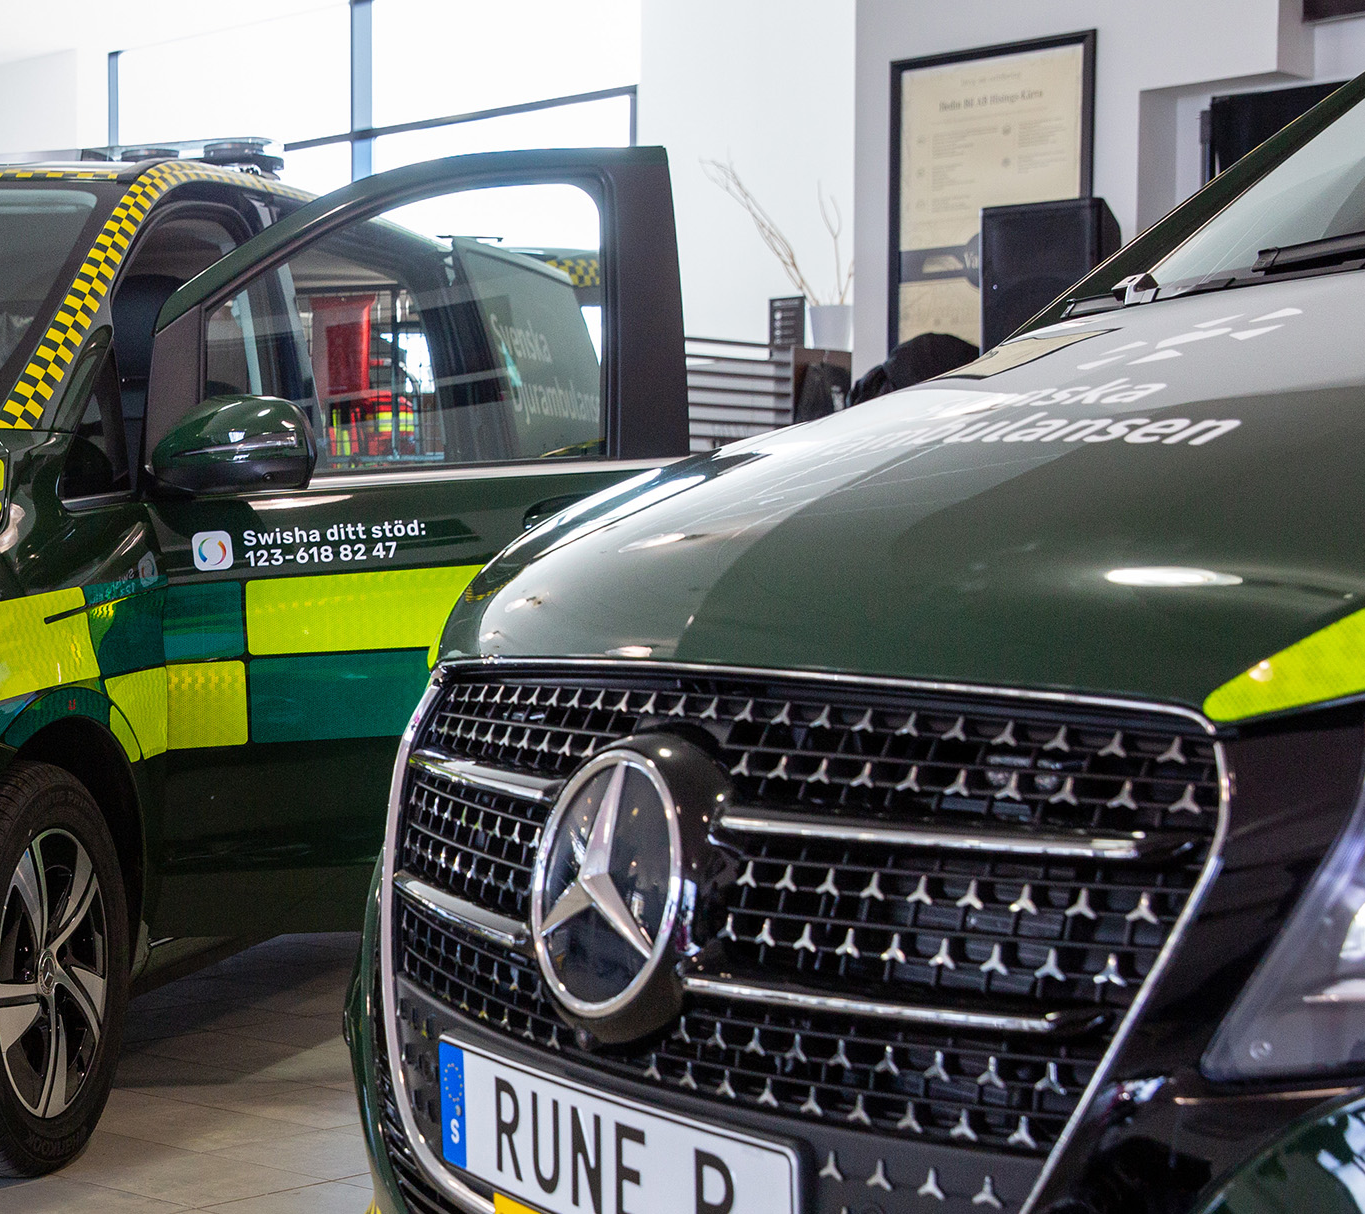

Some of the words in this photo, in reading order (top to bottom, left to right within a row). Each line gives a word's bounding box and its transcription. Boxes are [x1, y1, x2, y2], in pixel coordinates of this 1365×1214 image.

[243, 526, 321, 547] Swisha
[326, 522, 367, 542] ditt
[371, 518, 427, 539] stöd:
[244, 544, 334, 568] 123-618
[339, 543, 367, 562] 82
[372, 541, 398, 560] 47
[450, 1118, 460, 1145] S
[494, 1075, 647, 1214] RUNE
